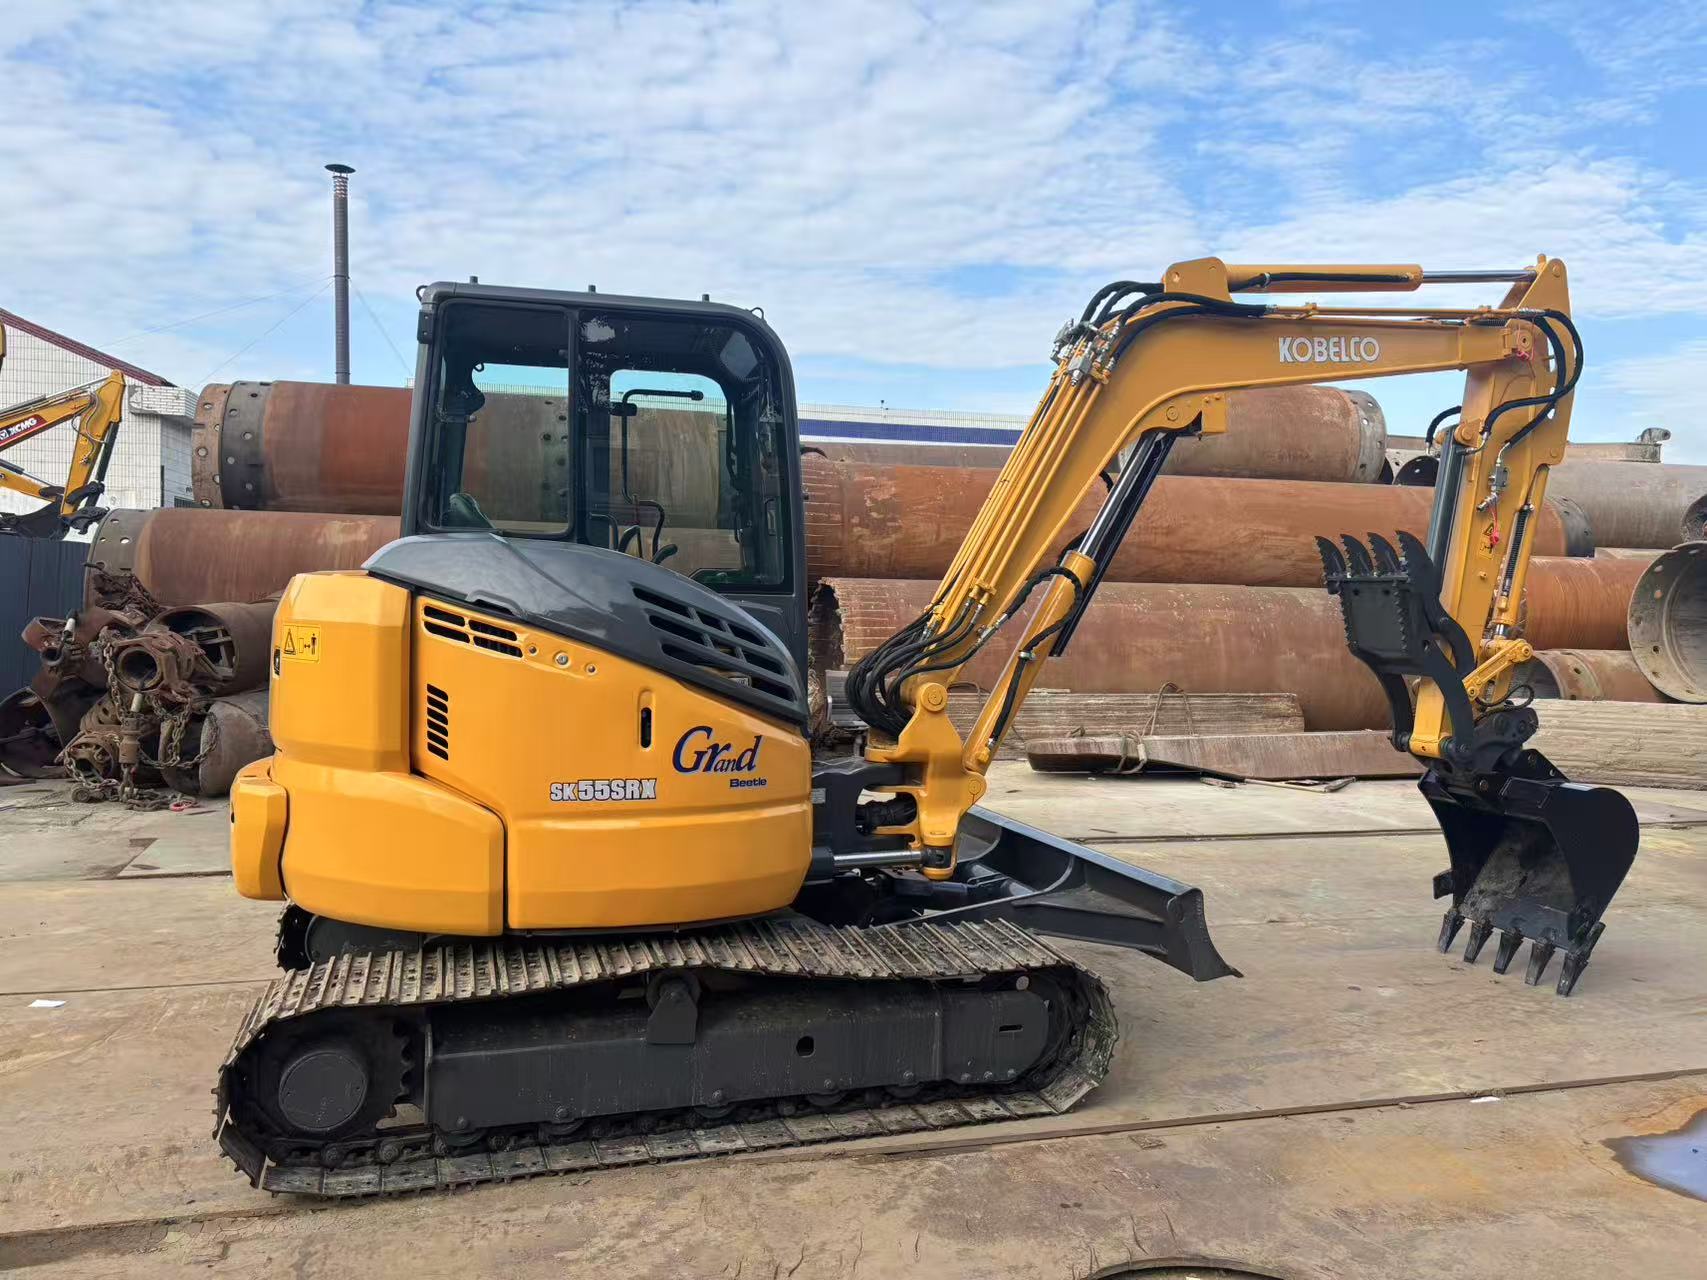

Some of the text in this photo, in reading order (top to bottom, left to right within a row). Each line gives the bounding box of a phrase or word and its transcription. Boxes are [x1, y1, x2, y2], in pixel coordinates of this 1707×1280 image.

[1278, 336, 1380, 363] KOBELCO
[8, 417, 37, 436] XCMG
[672, 725, 763, 775] Grand
[549, 778, 657, 801] SK55SRX
[729, 777, 767, 789] Beetle
